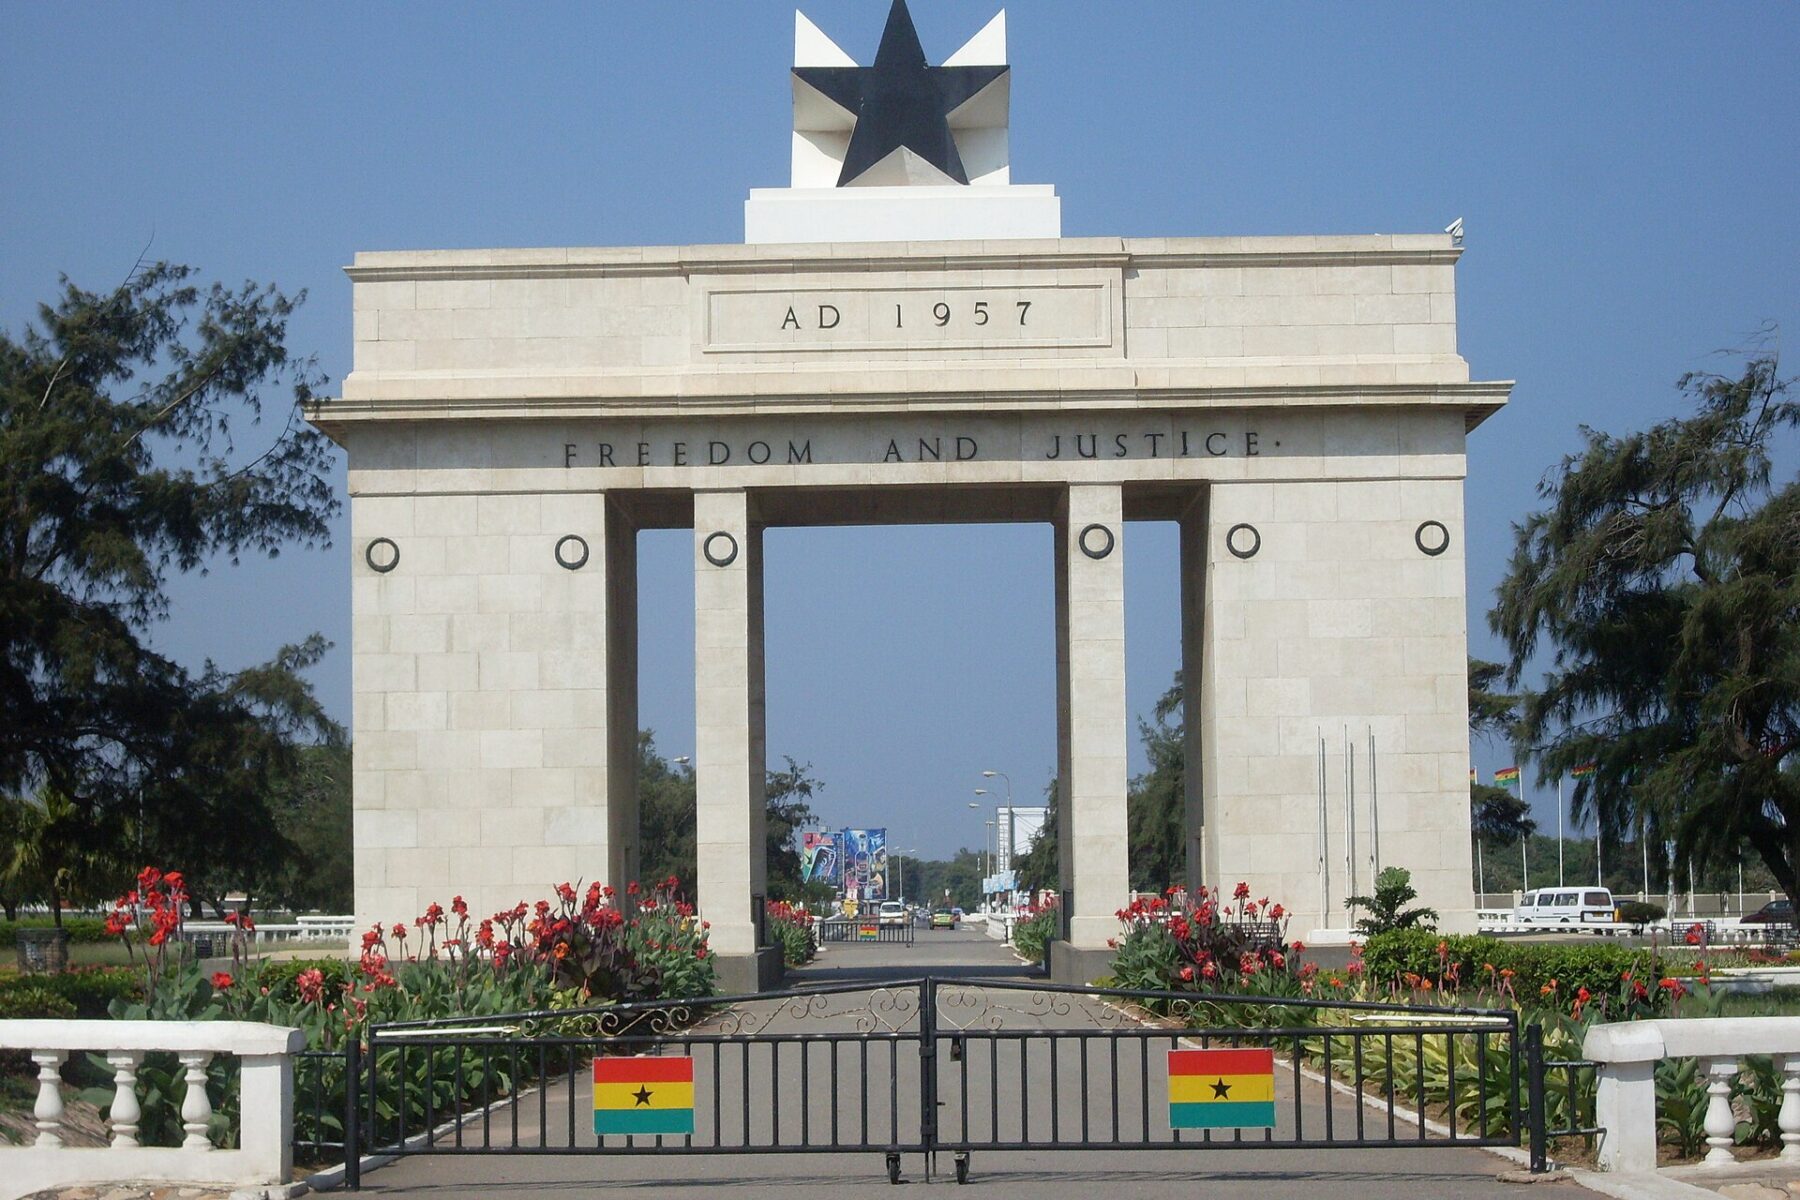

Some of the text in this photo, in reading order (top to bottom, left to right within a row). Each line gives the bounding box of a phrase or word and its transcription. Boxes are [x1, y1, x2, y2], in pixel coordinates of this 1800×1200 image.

[781, 302, 1032, 329] AD 1957
[564, 439, 813, 468] FREEDOM
[883, 436, 978, 463] AND
